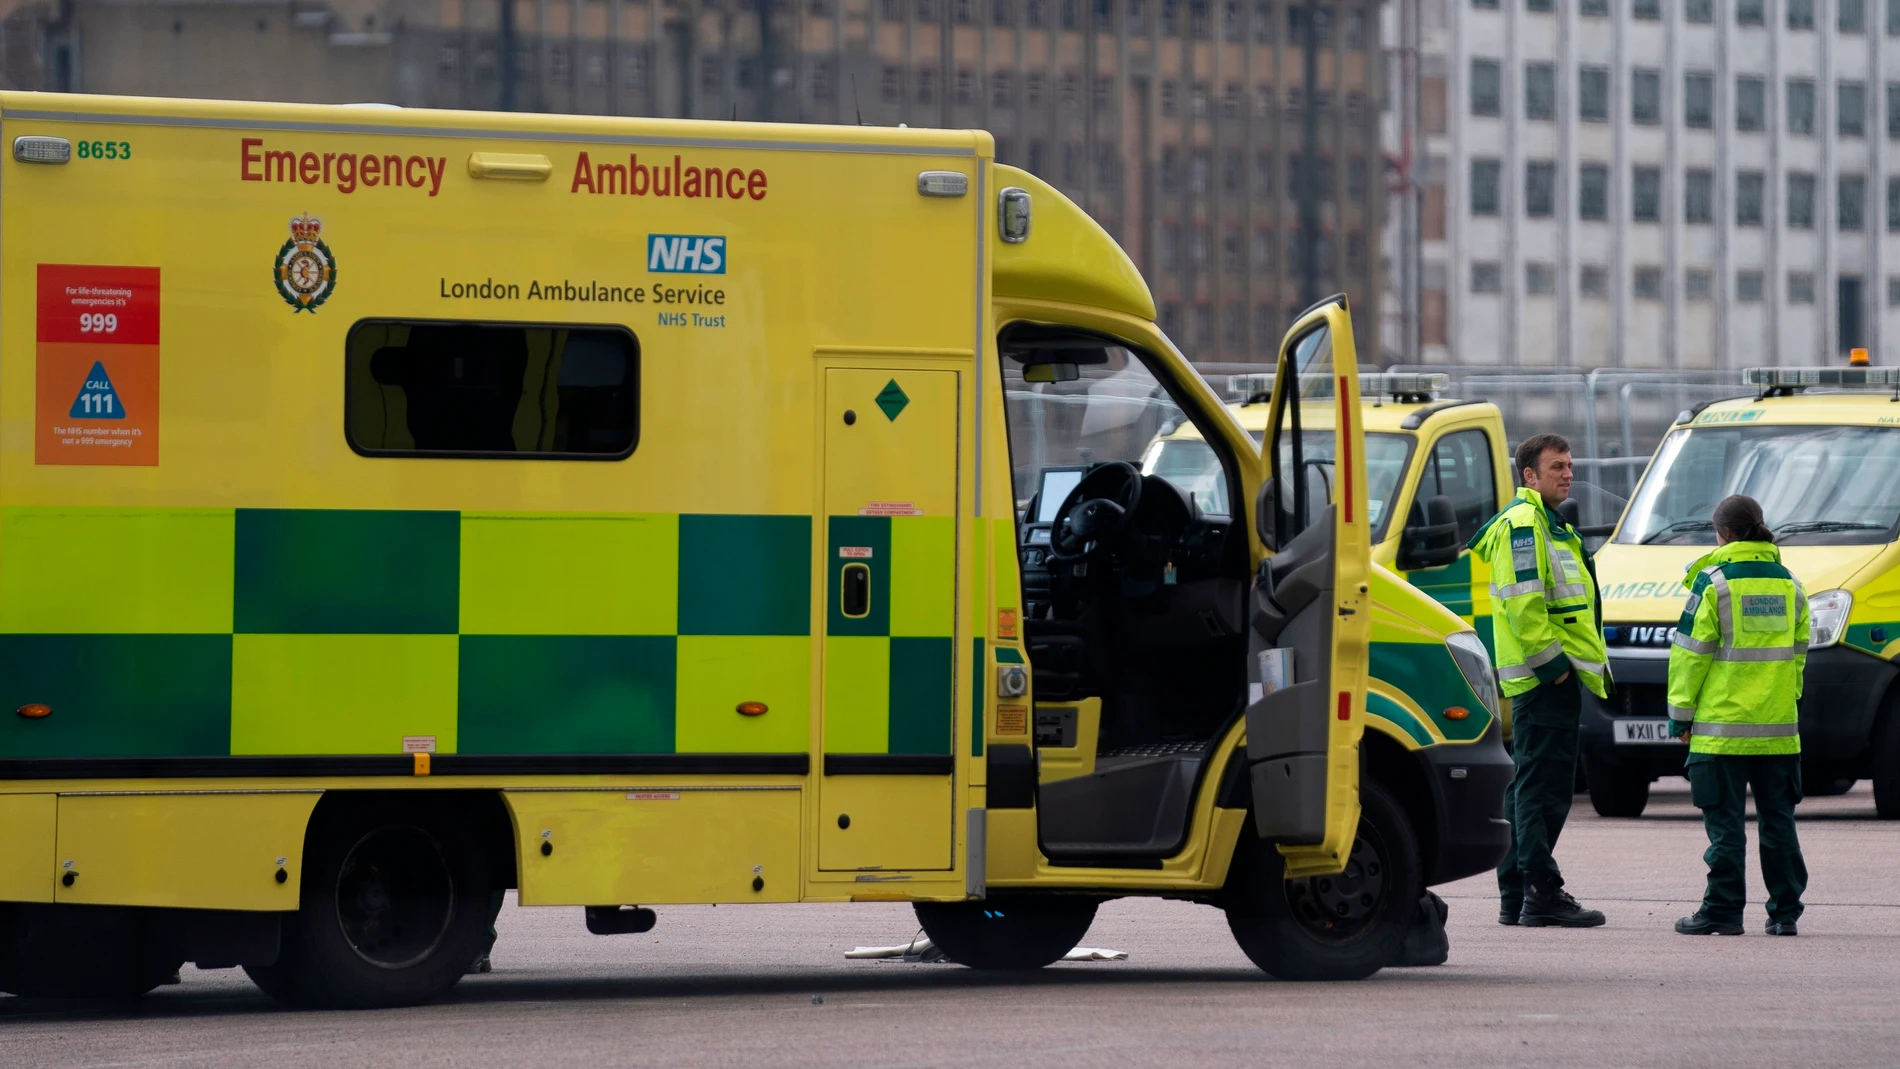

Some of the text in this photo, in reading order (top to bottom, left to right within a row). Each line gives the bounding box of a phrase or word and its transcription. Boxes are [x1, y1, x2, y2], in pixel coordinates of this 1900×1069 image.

[77, 140, 131, 160] 8653
[241, 137, 768, 201] Emergency Ambulance
[649, 236, 724, 272] NHS
[78, 287, 132, 298] life-threatening
[440, 277, 726, 306] London Ambulance Service
[71, 298, 115, 306] emergencies
[80, 313, 118, 333] 999
[658, 312, 726, 328] NHS Trust
[86, 380, 110, 389] CALL
[81, 393, 113, 413] 111
[53, 427, 66, 435] The
[67, 427, 82, 435] NHS
[83, 427, 109, 435] number
[95, 438, 133, 447] emergency
[1513, 537, 1534, 548] NHS
[1600, 580, 1688, 600] AMBUL
[1750, 597, 1779, 606] LONDON
[1744, 606, 1786, 615] AMBULANCE
[1630, 626, 1677, 642] IVEC
